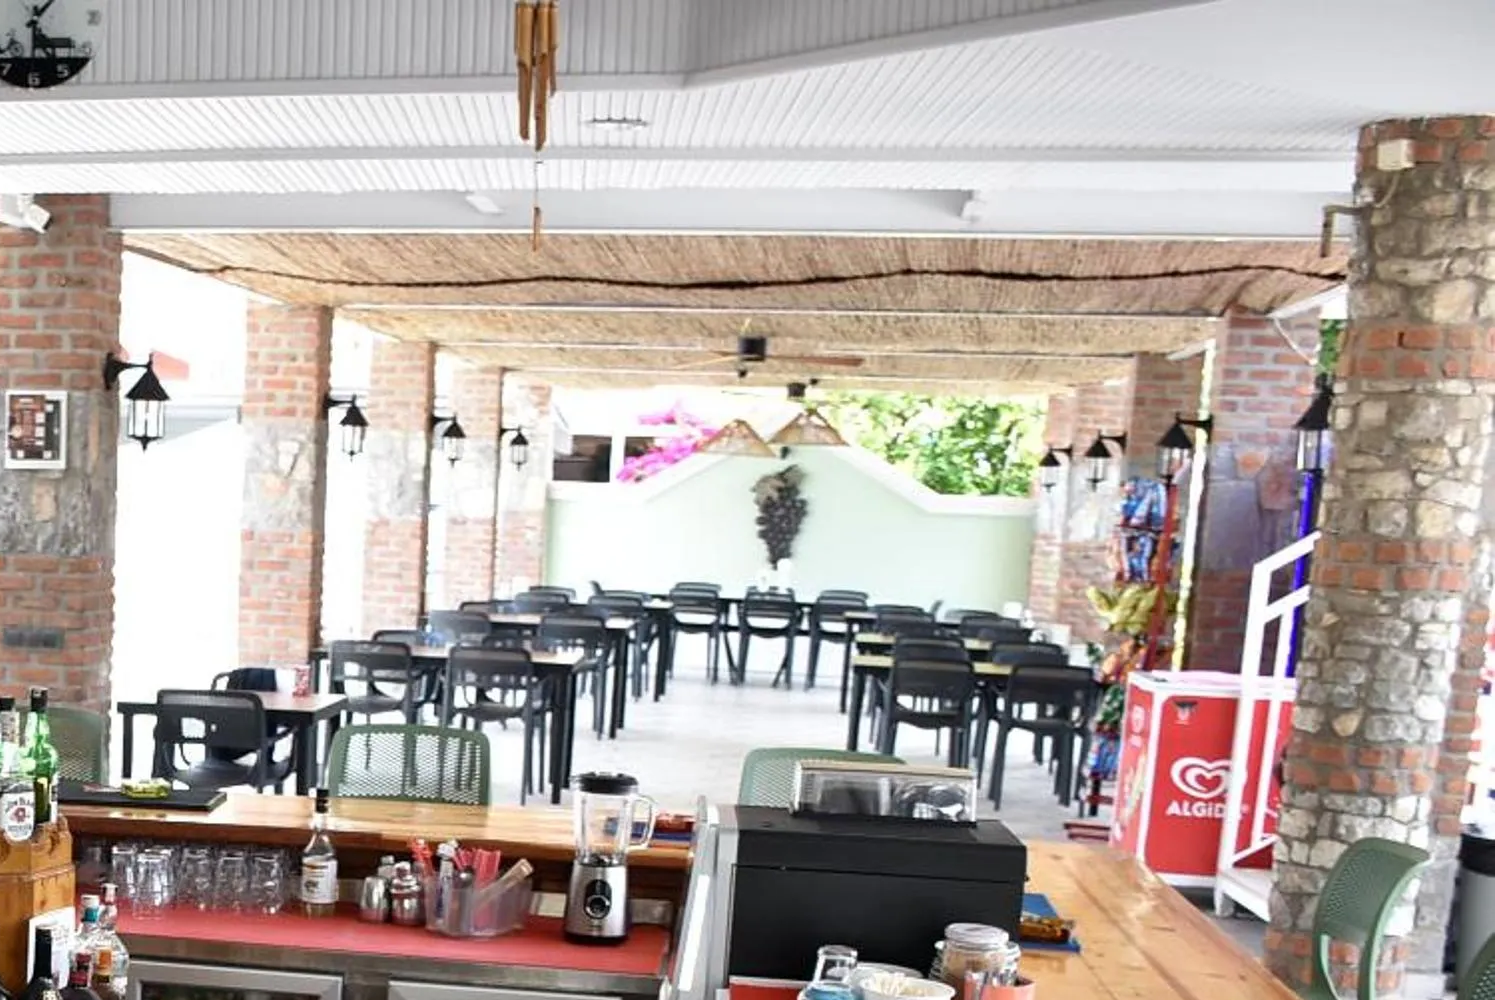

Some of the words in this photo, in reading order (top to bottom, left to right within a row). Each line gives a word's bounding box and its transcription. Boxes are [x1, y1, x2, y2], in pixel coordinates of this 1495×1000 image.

[0, 63, 13, 76] 7
[57, 64, 70, 78] 5
[27, 72, 41, 86] 6
[1165, 800, 1249, 819] ALGID
